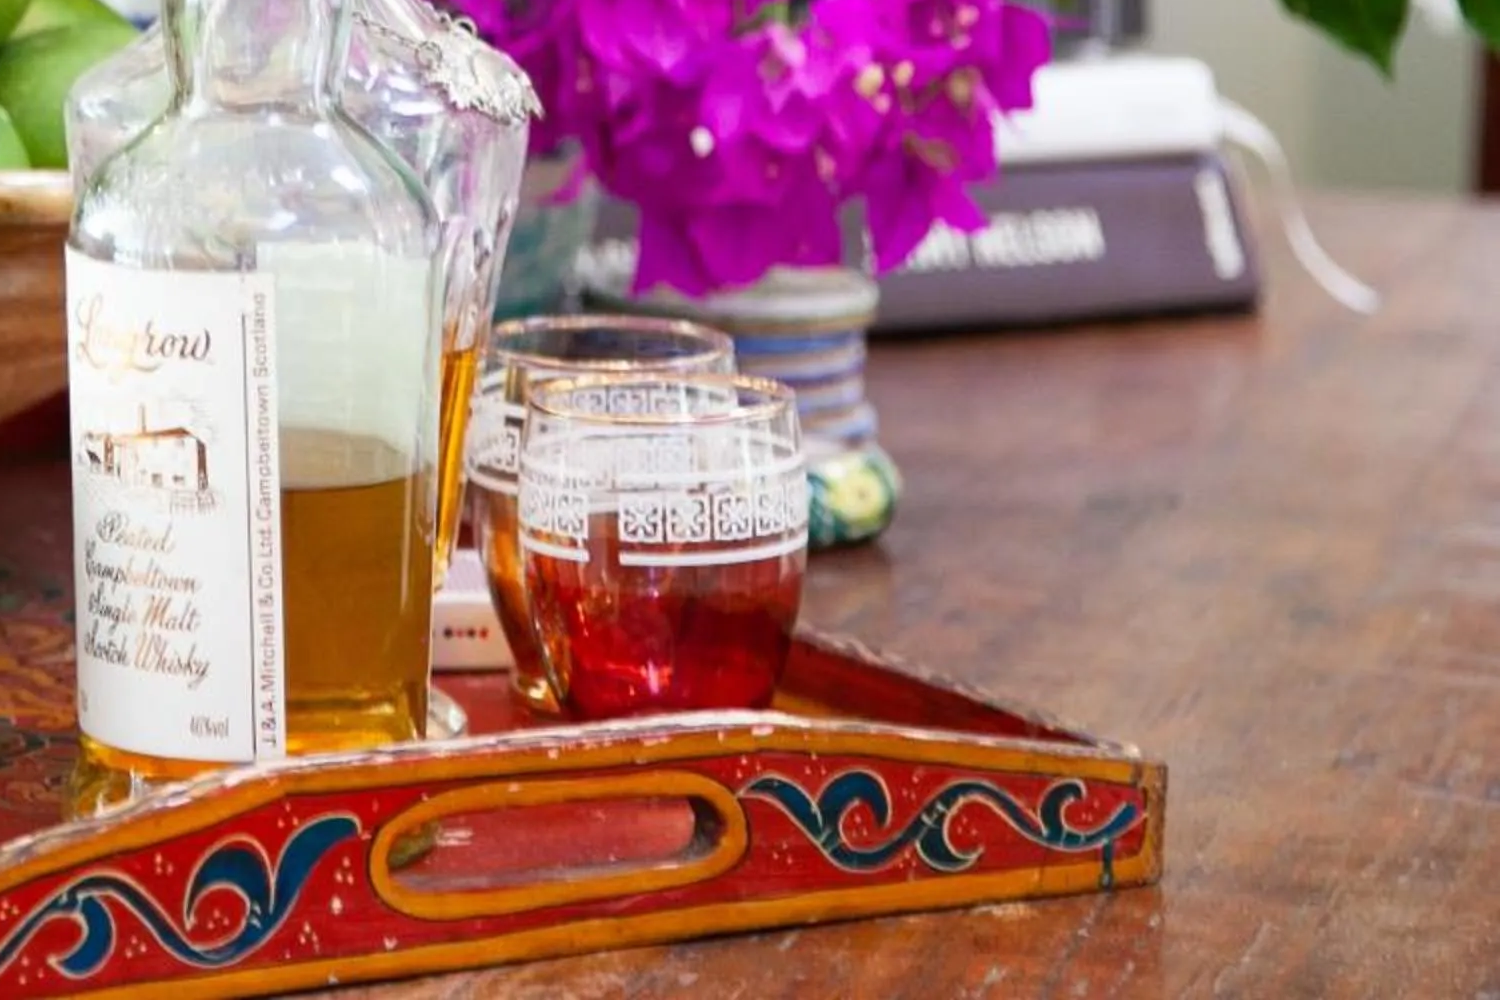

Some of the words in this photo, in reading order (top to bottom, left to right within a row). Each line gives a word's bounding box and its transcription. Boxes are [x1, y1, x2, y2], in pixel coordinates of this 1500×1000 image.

[251, 293, 269, 378] Scotland
[253, 385, 274, 520] Campbeltown
[143, 595, 200, 632] Malt
[260, 613, 276, 691] Mitchell
[135, 633, 210, 690] Whisky
